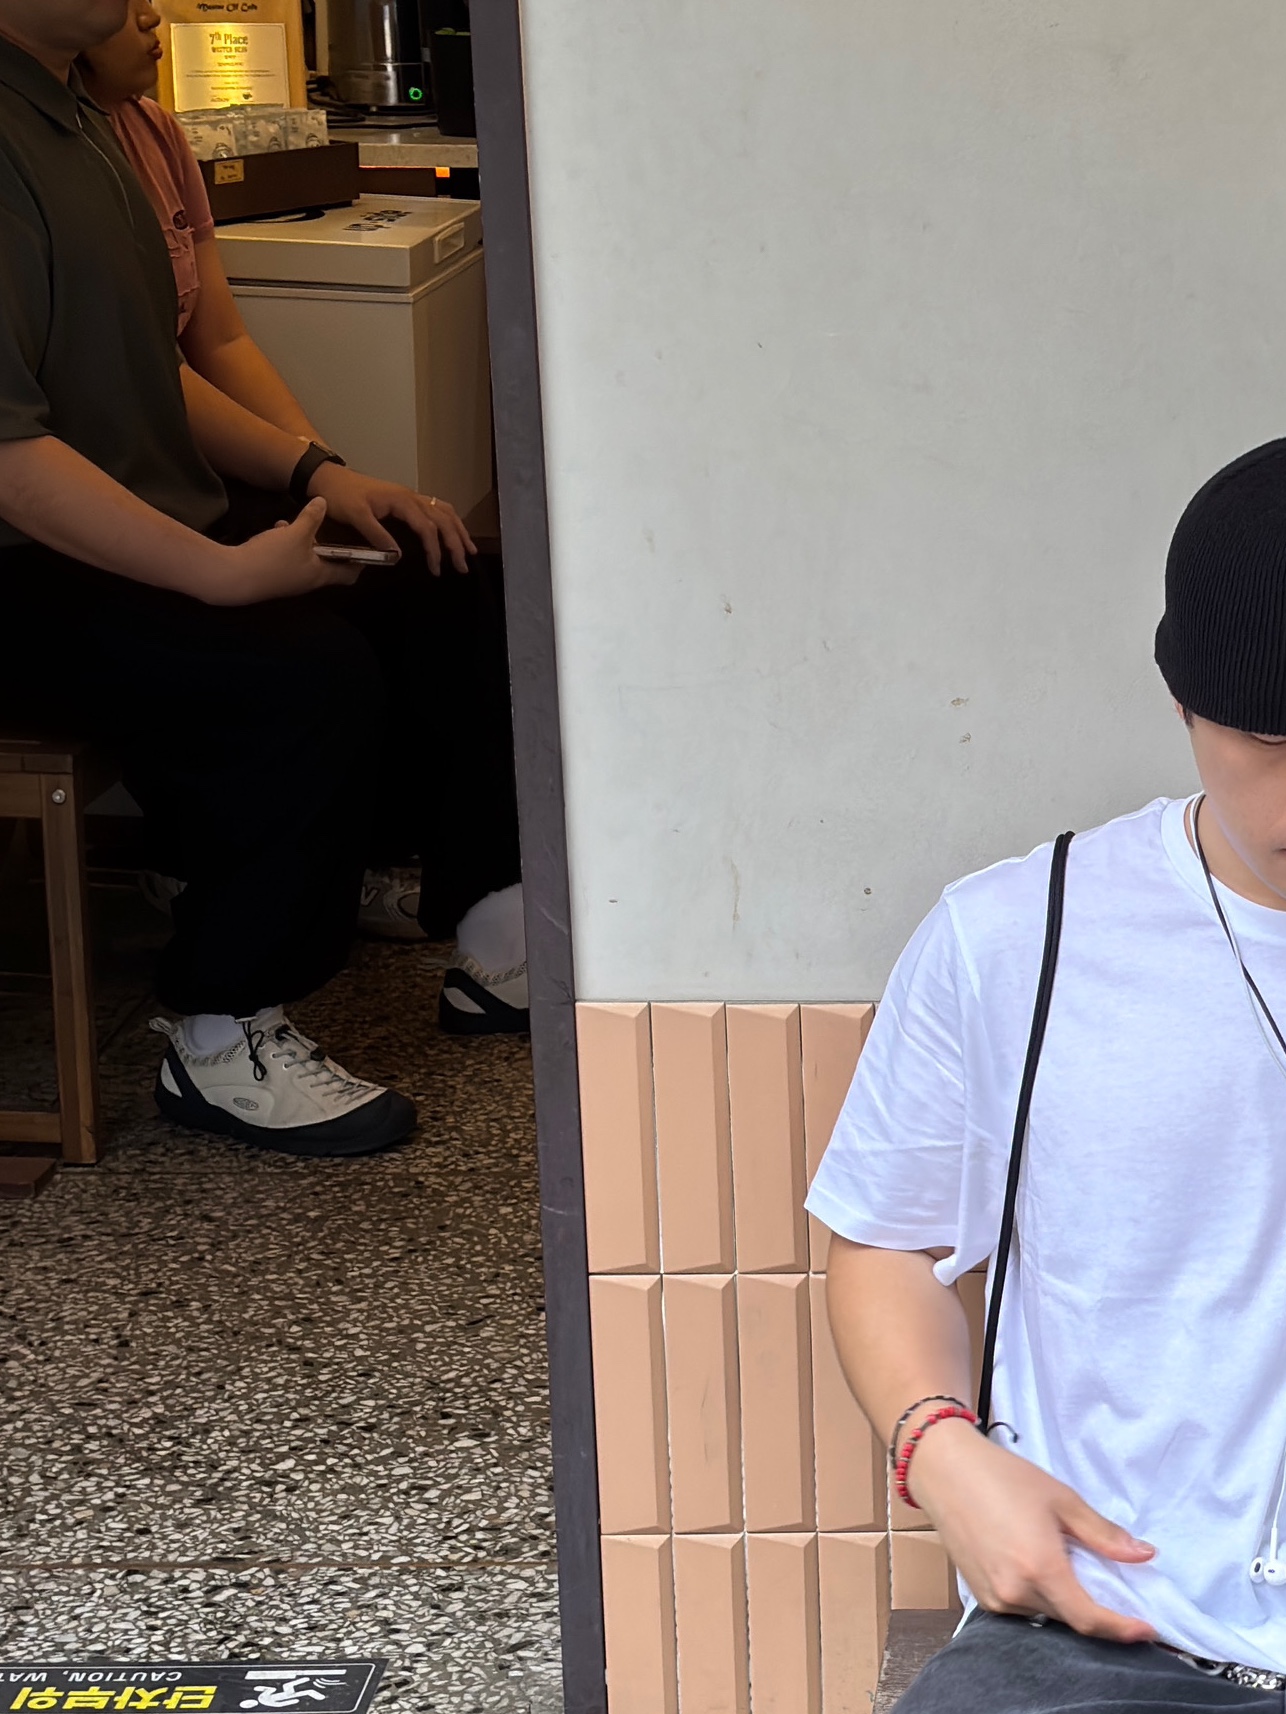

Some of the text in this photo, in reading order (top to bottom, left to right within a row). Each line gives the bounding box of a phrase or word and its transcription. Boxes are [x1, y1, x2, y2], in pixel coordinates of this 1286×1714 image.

[224, 33, 249, 45] Place
[62, 1670, 183, 1682] CAUTION,
[9, 1685, 218, 1710] 단차부위
